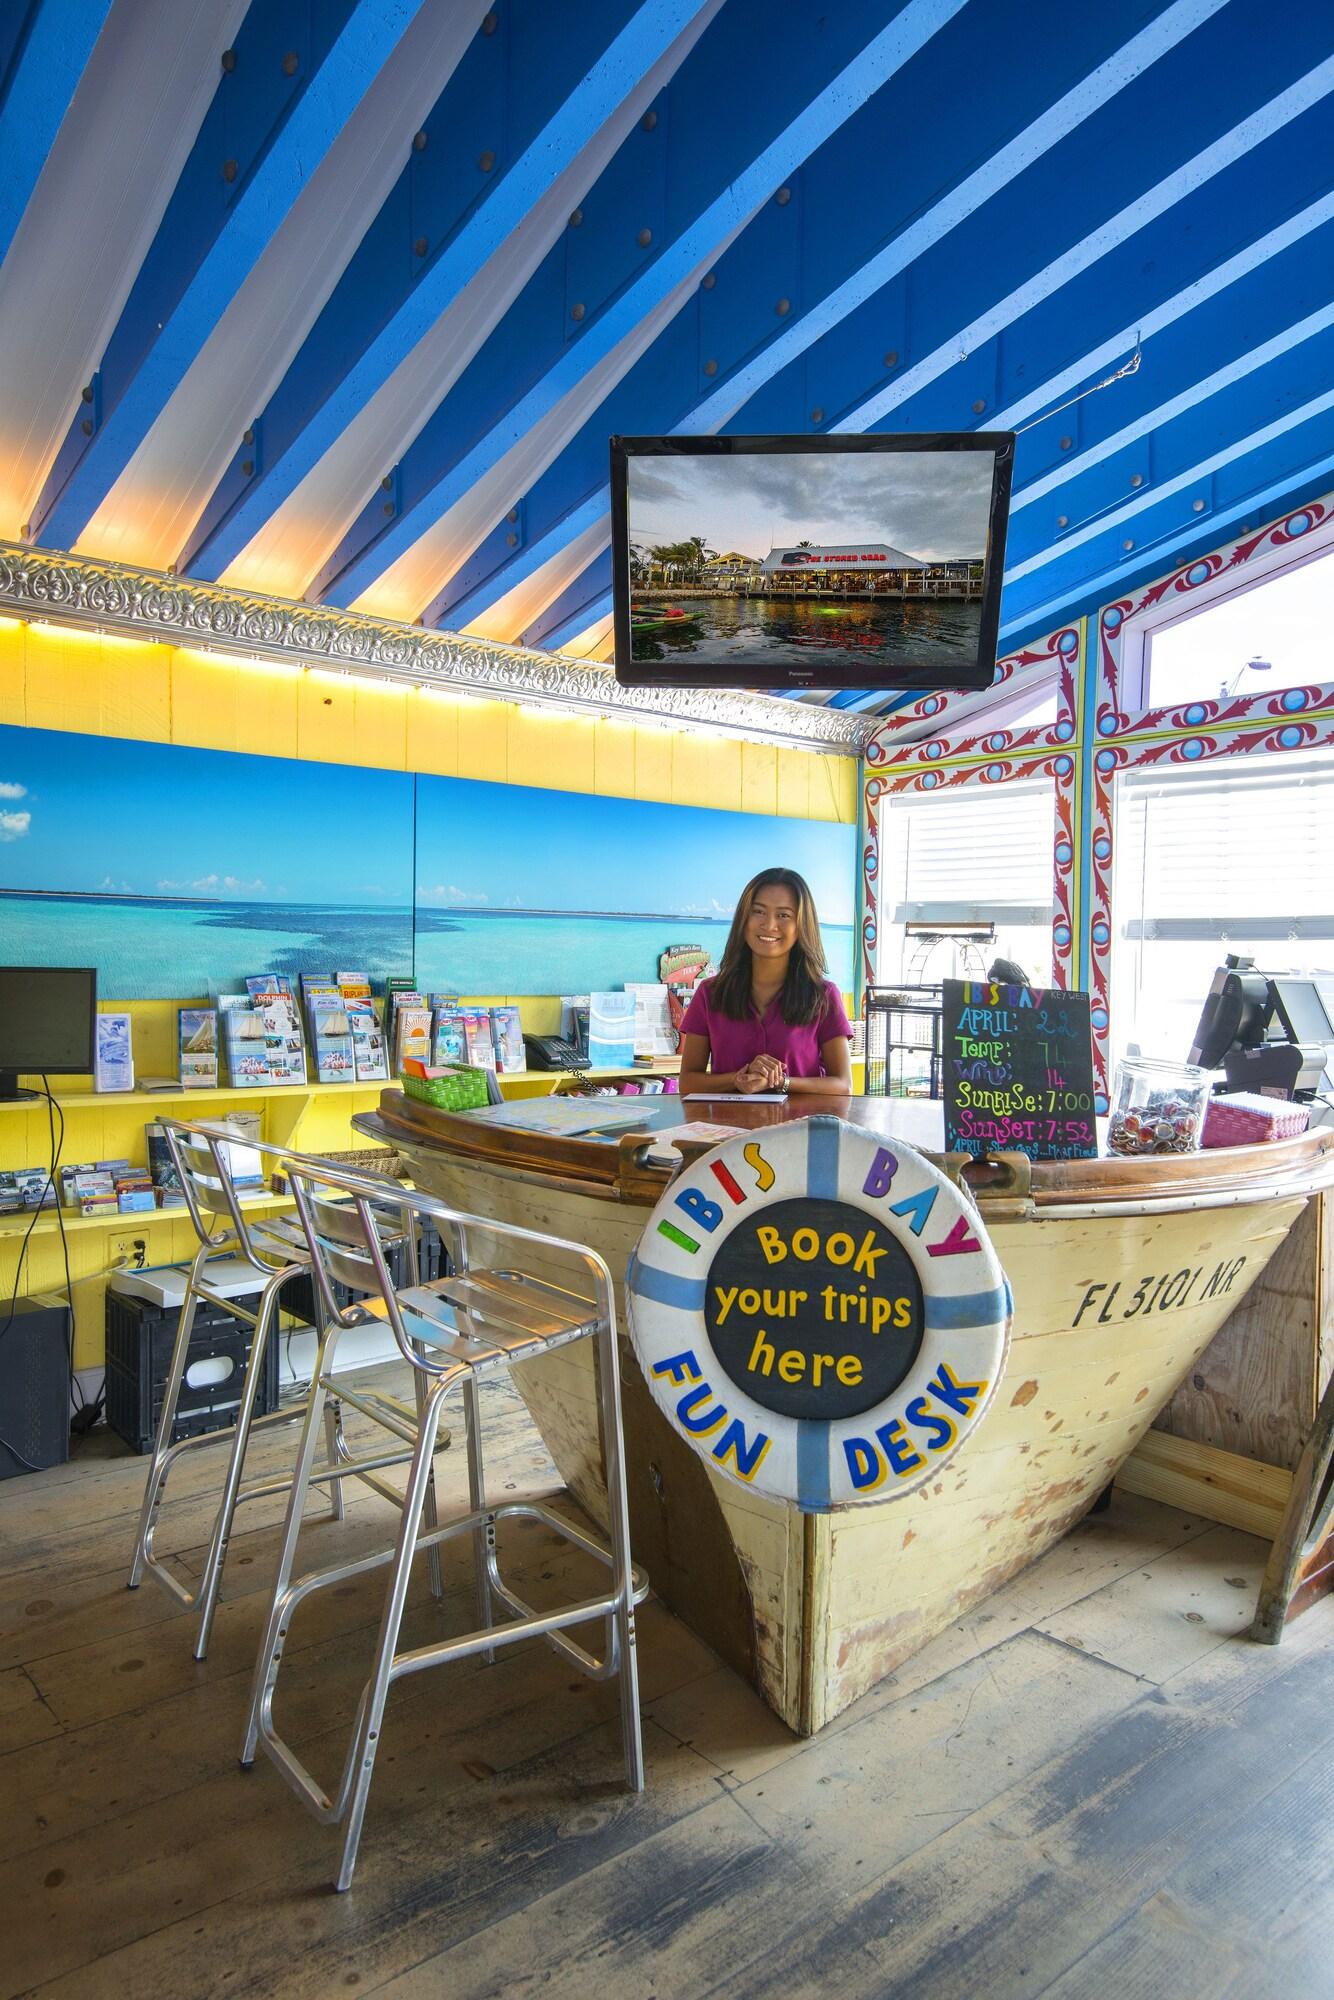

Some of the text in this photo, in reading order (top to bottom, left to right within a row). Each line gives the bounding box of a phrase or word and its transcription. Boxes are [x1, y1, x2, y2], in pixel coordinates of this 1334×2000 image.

[963, 980, 1000, 1006] IBIS
[1046, 1068, 1067, 1090] 14
[656, 1142, 983, 1257] IBIS BAY
[715, 1285, 912, 1335] your trips
[1072, 1281, 1121, 1327] FL
[1123, 1266, 1204, 1318] 3101
[748, 1330, 864, 1388] here
[651, 1349, 989, 1493] FUN DESK
